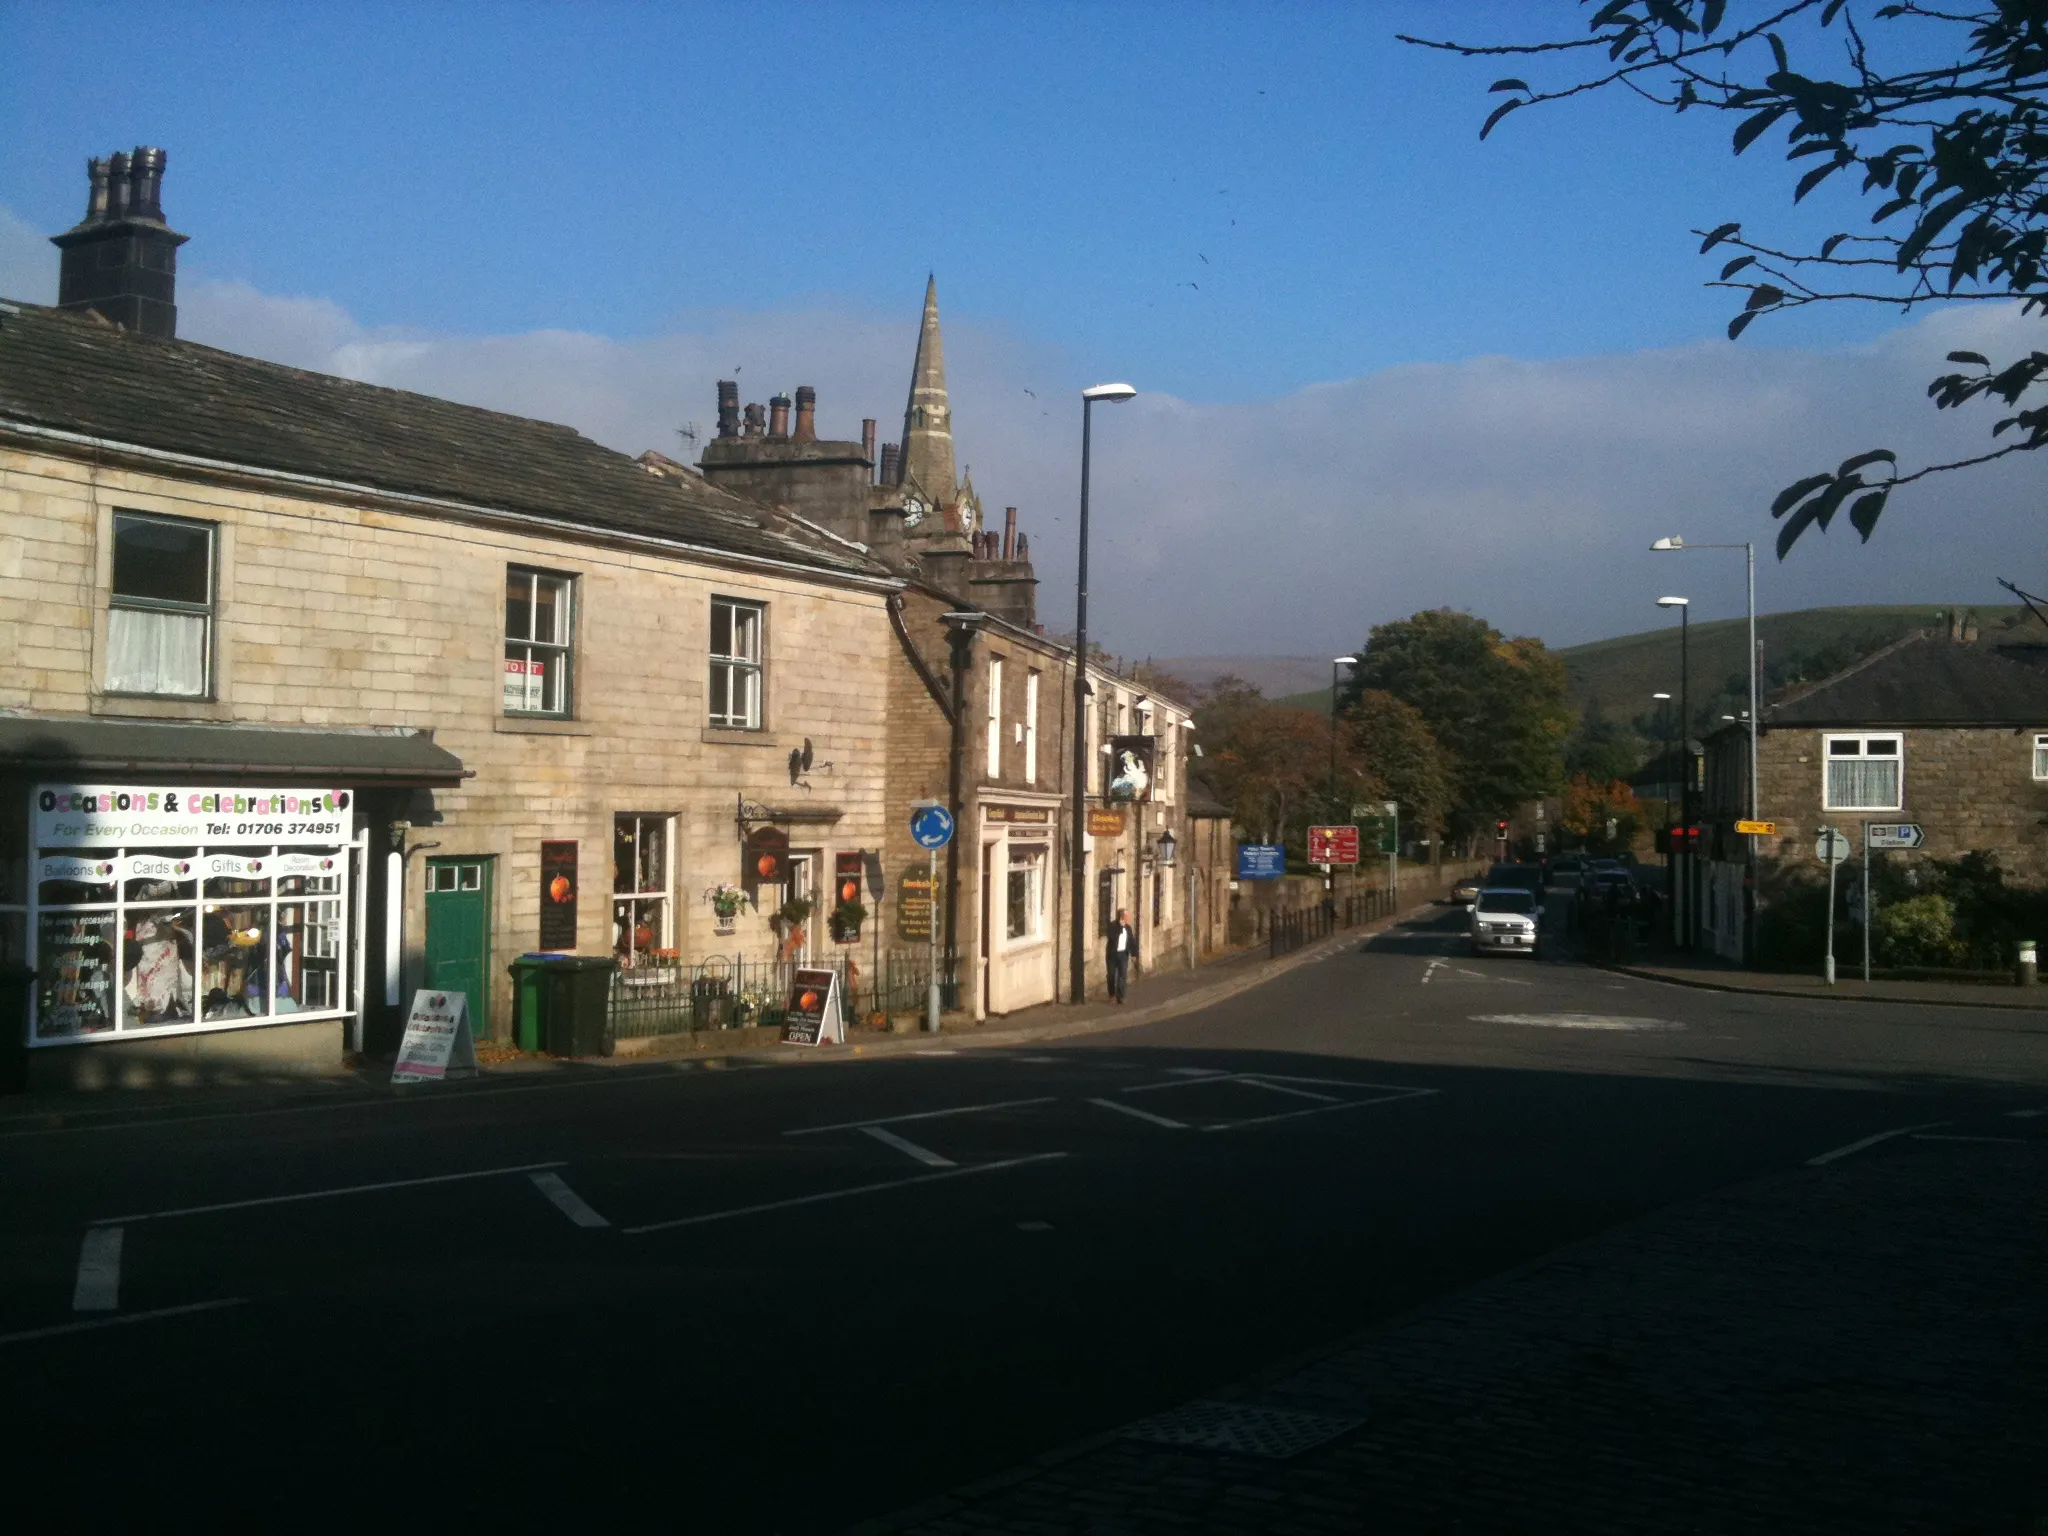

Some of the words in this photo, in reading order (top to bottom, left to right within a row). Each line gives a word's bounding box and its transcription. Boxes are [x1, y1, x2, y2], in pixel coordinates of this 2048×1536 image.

[520, 662, 539, 674] LT
[39, 789, 159, 813] Occasions
[164, 792, 180, 813] &
[187, 793, 322, 816] Celebrations
[53, 823, 80, 836] For
[84, 823, 127, 838] Every
[131, 823, 198, 836] Occasion
[206, 822, 230, 835] Tel:
[237, 822, 283, 835] 01706
[287, 822, 340, 835] 374951
[44, 863, 94, 877] Balloons
[133, 859, 170, 875] Cards
[210, 858, 242, 873] Gifts
[903, 878, 940, 889] Bookshp
[788, 1031, 812, 1043] OPEN
